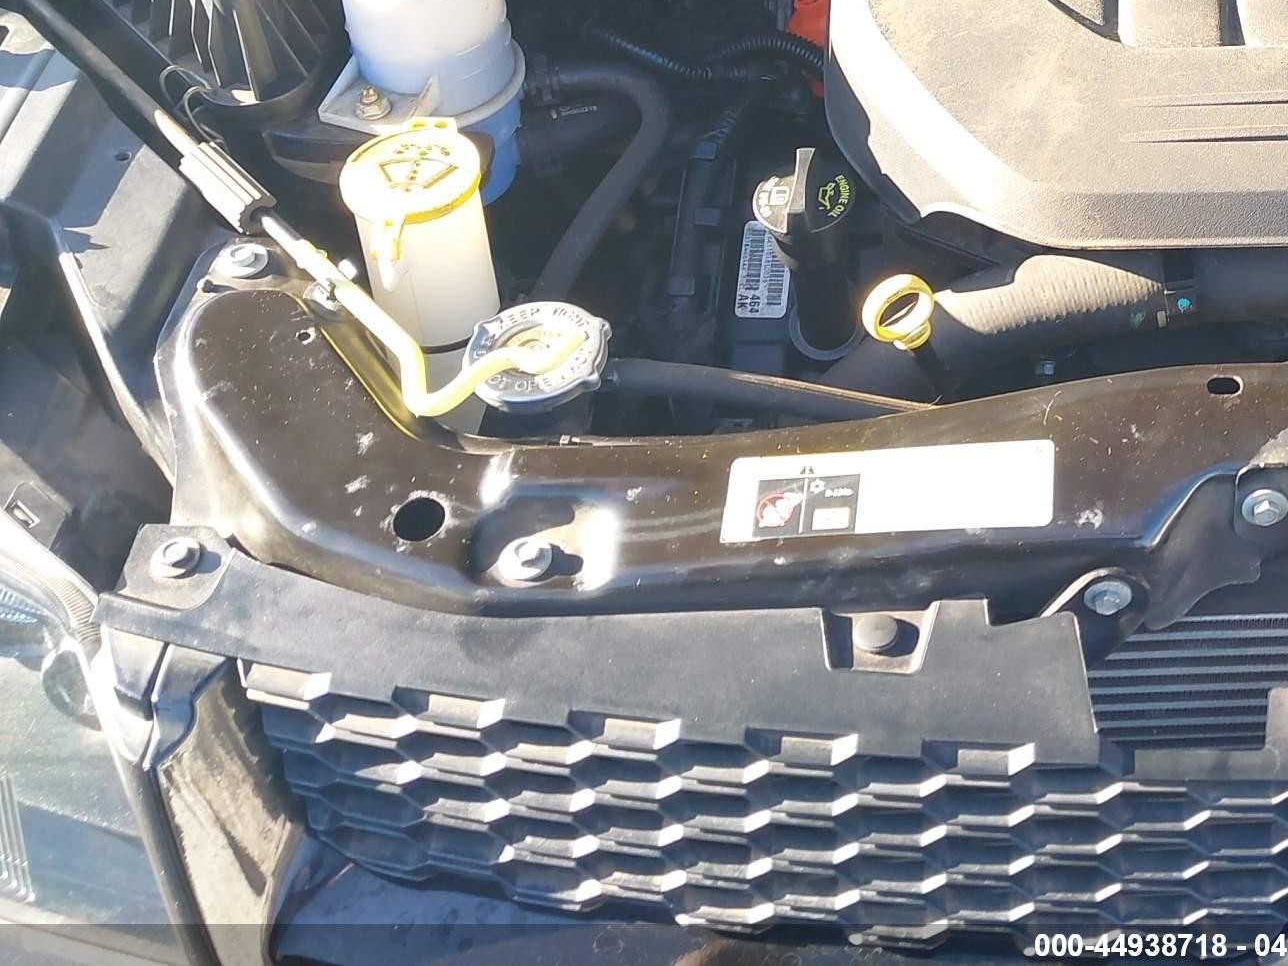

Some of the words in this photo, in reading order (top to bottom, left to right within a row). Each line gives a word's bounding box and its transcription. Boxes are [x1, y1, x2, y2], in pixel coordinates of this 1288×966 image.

[835, 175, 850, 204] ENGINE
[827, 205, 844, 218] OIL
[737, 294, 749, 309] AK
[748, 294, 760, 313] 464
